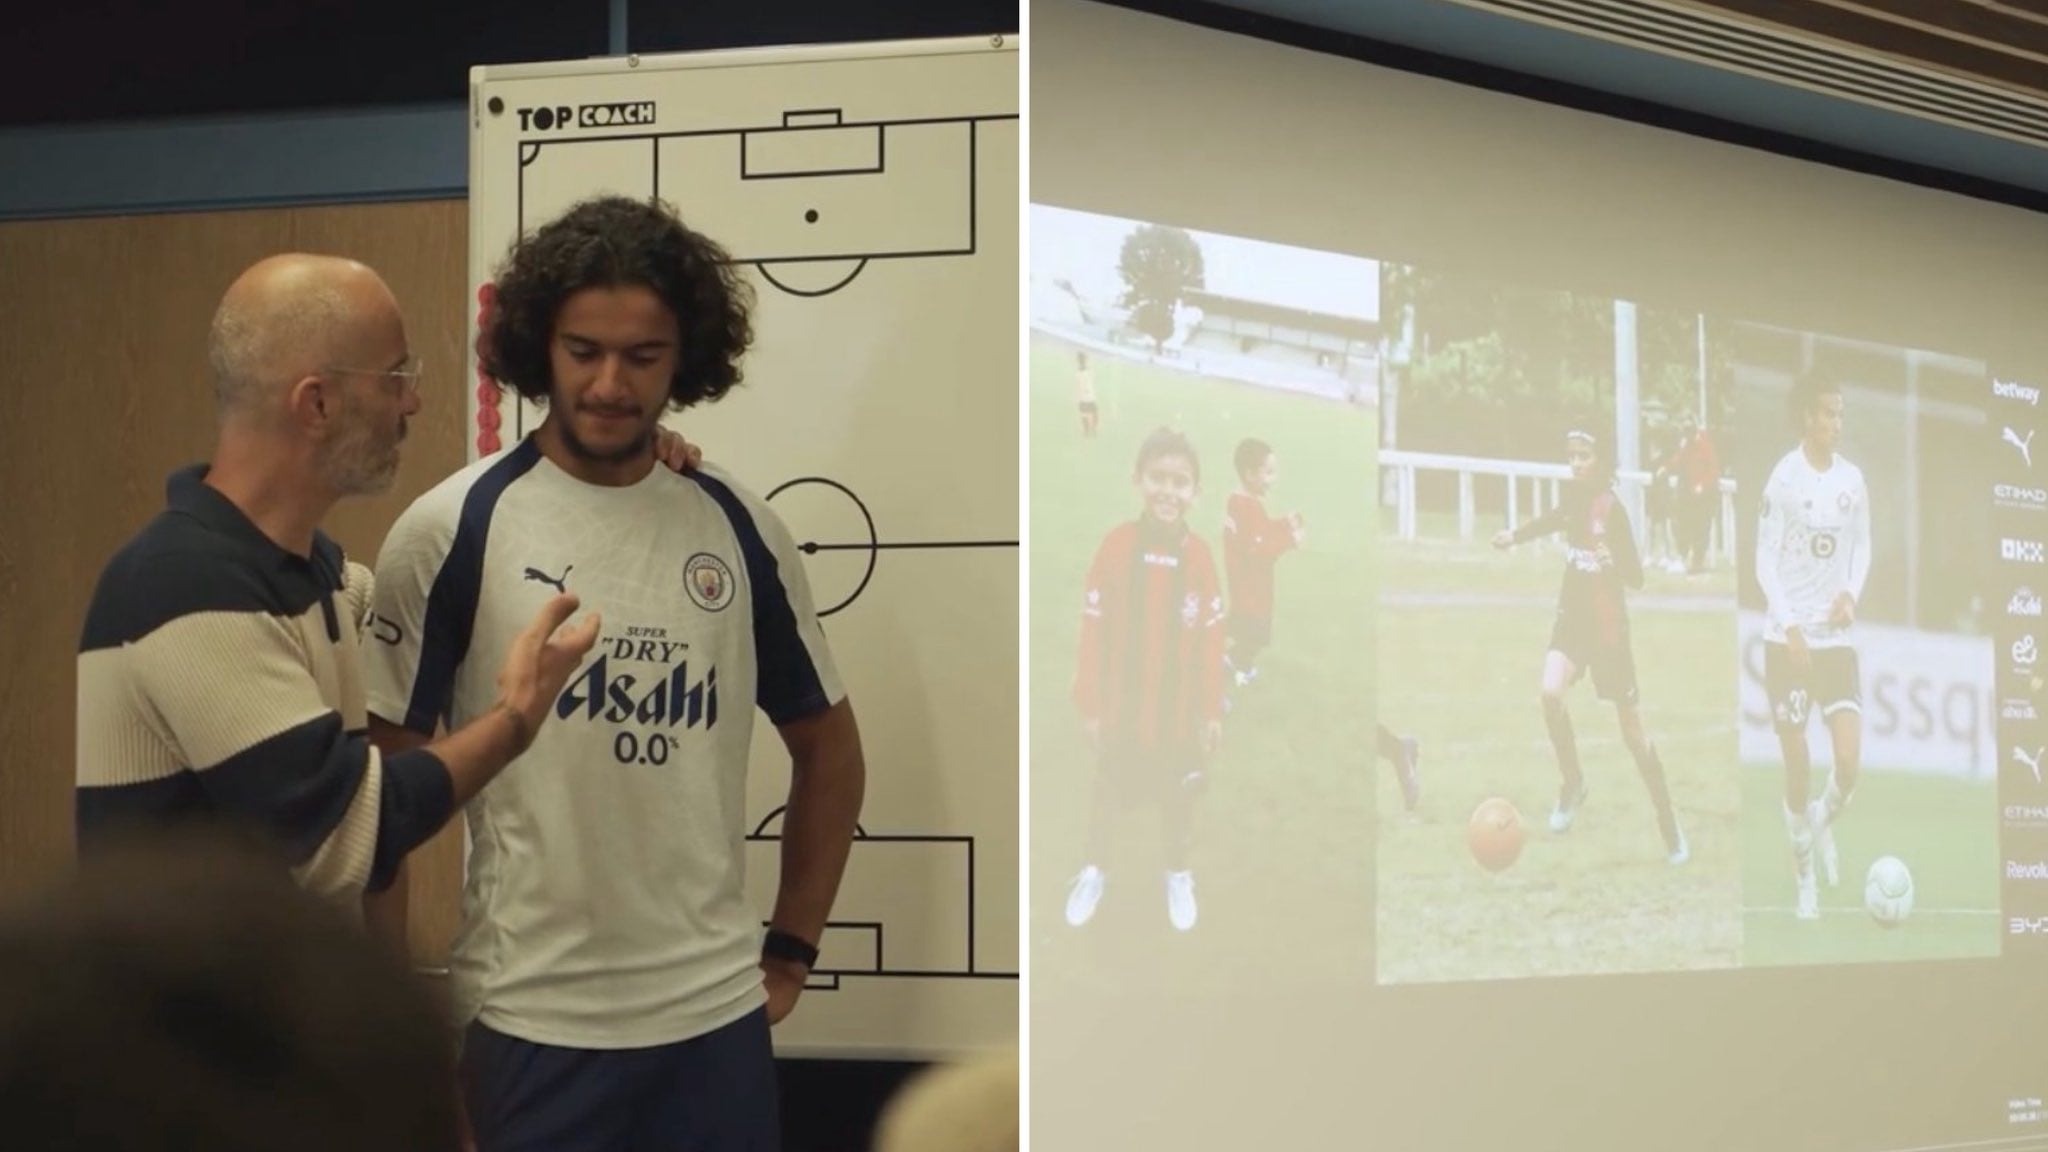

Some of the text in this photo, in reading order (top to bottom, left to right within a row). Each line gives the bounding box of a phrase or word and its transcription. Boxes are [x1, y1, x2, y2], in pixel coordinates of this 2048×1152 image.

[517, 102, 655, 131] TOP COACH
[1993, 378, 2040, 406] betway
[1994, 484, 2047, 502] ETIHAD
[626, 625, 668, 638] SUPER
[556, 653, 718, 731] Asahi
[613, 731, 680, 766] 0.0%
[2004, 805, 2048, 820] ETIHA
